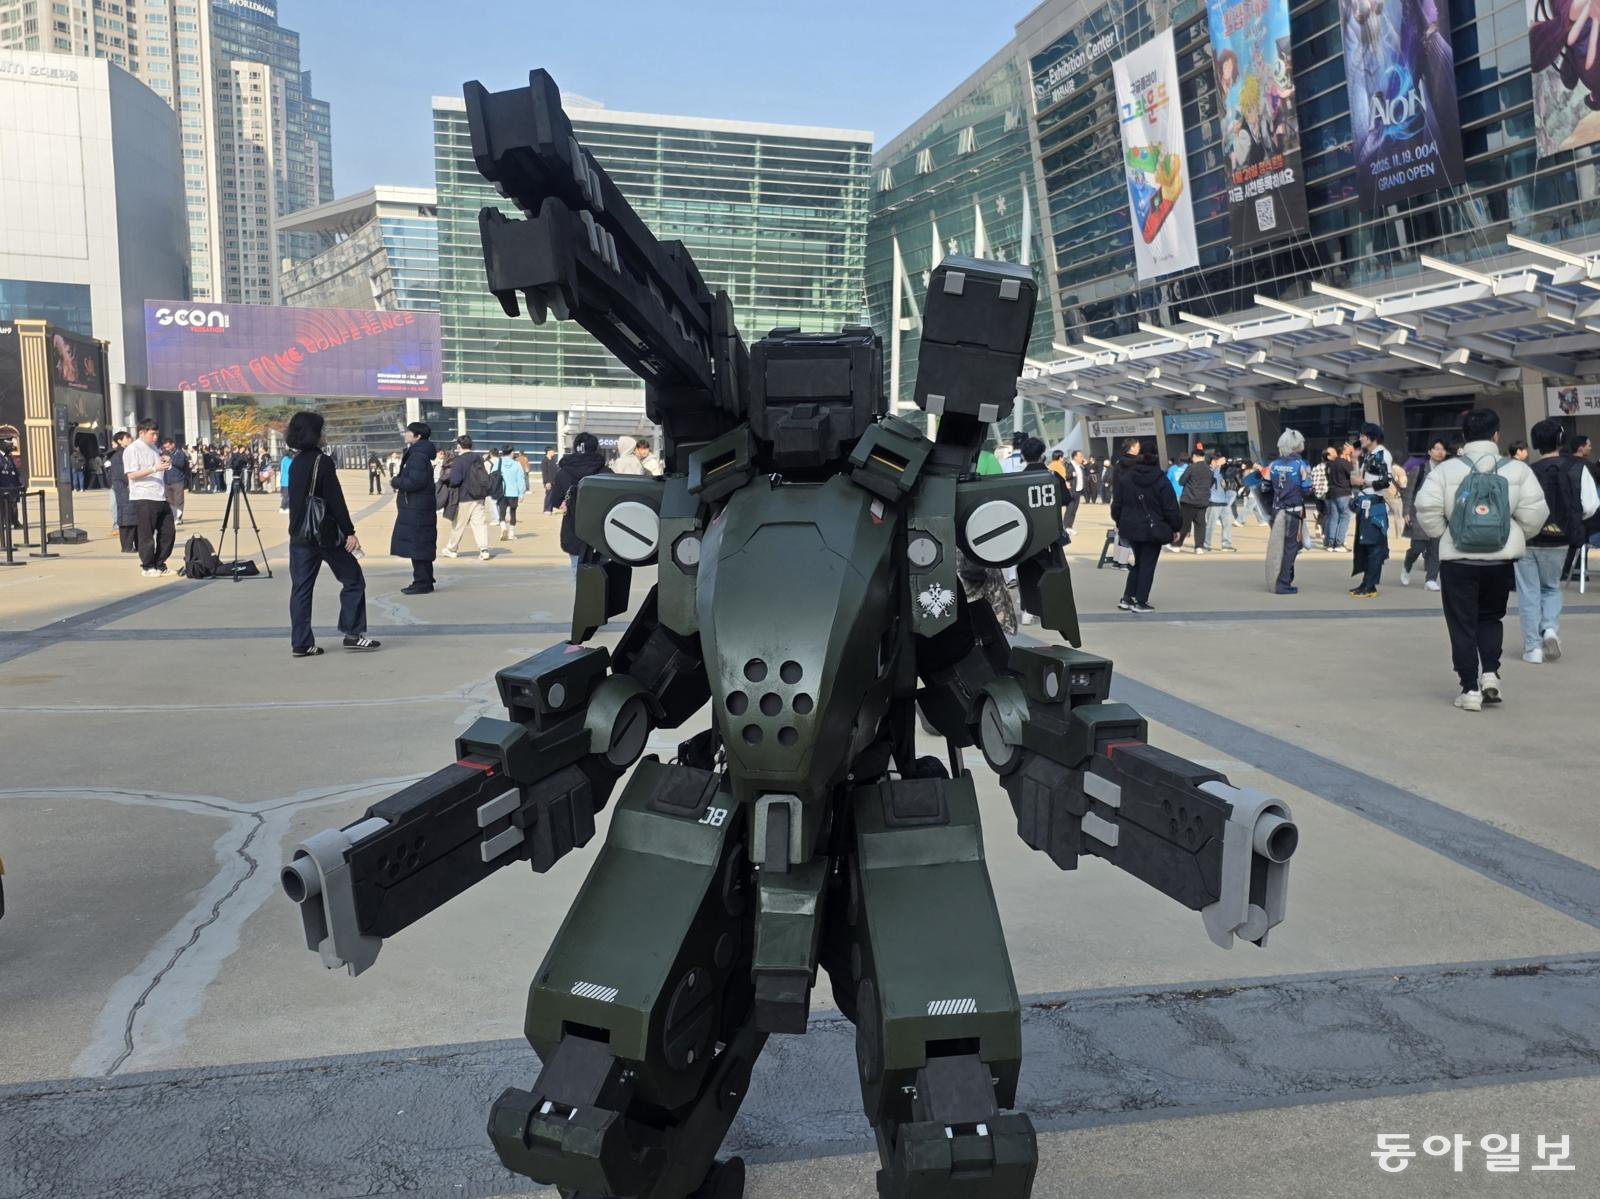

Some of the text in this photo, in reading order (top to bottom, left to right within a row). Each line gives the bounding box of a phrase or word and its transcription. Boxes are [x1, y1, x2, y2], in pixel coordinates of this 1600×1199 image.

[1048, 52, 1086, 85] Exhibition
[1085, 31, 1115, 60] Center
[1121, 83, 1169, 125] 그라운드
[1368, 78, 1427, 132] AION
[1228, 168, 1295, 203] 지금 사전등록하세요
[1378, 162, 1435, 191] GRAND OPEN
[1028, 484, 1056, 508] 08
